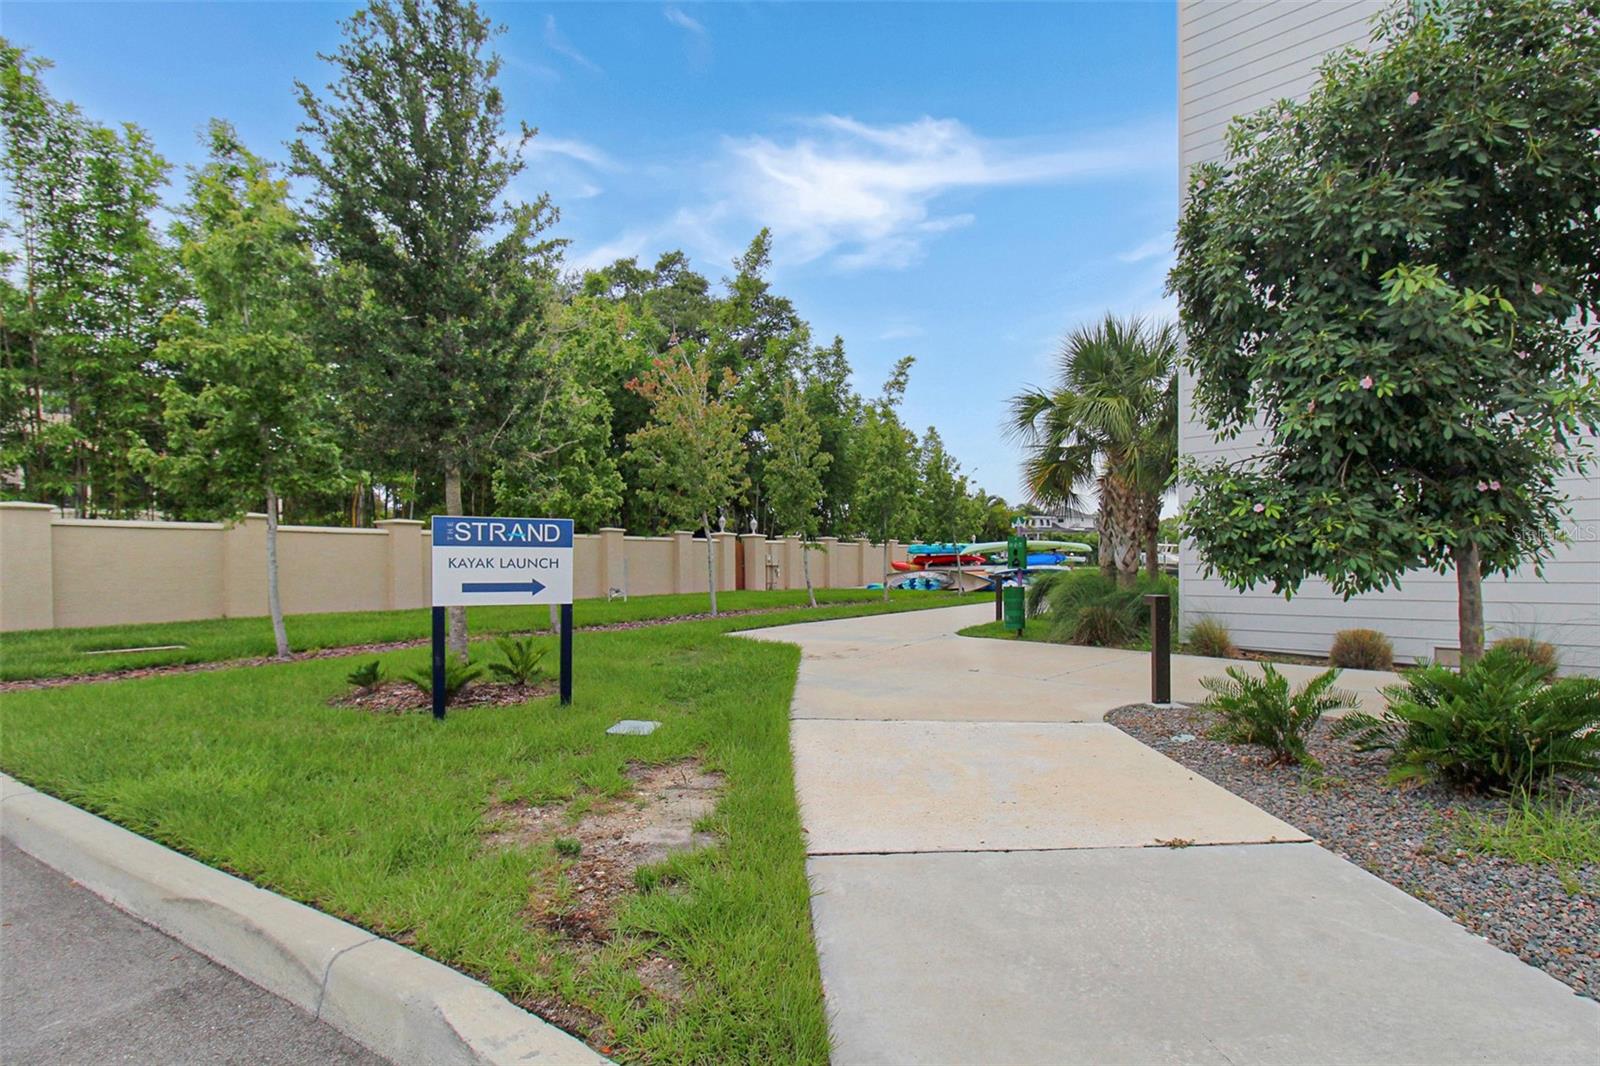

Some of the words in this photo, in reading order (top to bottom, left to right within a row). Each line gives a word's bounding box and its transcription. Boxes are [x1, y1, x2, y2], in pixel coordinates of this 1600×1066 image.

[455, 521, 561, 543] STRAND
[448, 557, 495, 569] KAYAK
[500, 557, 560, 569] LAUNCH
